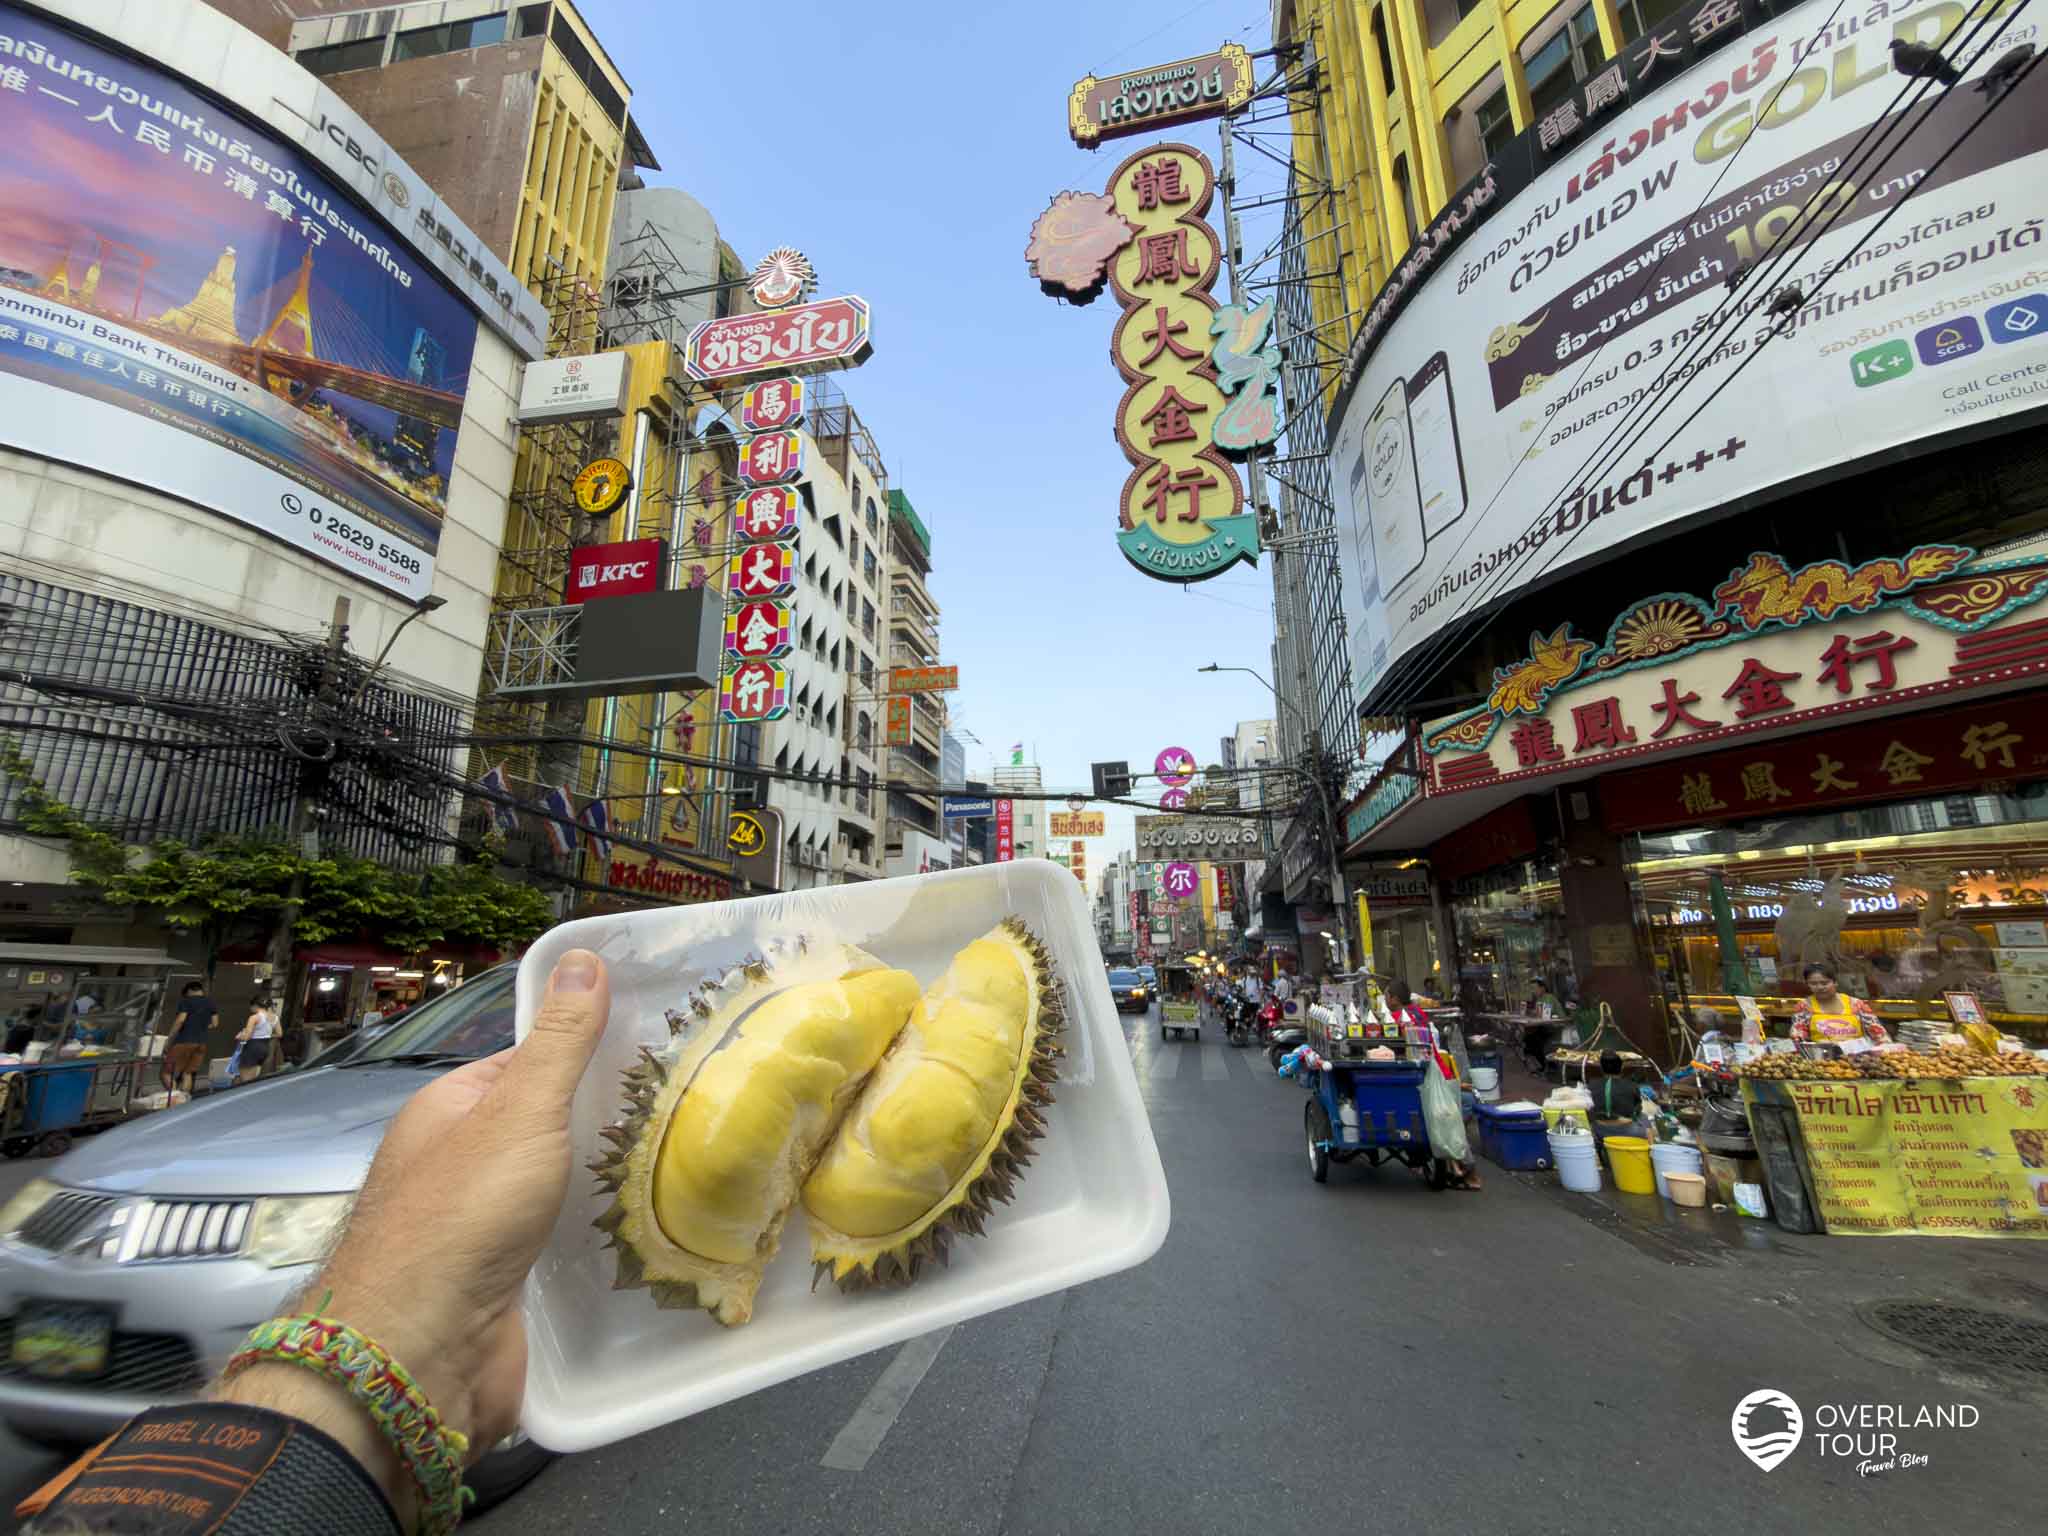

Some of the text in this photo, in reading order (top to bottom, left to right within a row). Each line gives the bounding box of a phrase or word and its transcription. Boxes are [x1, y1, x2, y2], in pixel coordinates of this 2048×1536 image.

[319, 114, 379, 178] ICBC
[1457, 36, 1778, 295] ซื้อทองกับ เล่งหงษ์
[1510, 161, 1678, 292] ด้วยแอพ
[1691, 156, 1842, 239] ไม่มีค่าใช้จ่าย
[1555, 299, 1650, 360] ซื้อ-ขาย
[1725, 179, 1856, 263] 100
[1870, 168, 1926, 201] บาท
[0, 295, 238, 392] nminbi Bank Thailand
[703, 311, 849, 370] ทองใบ
[1131, 157, 1218, 523] 龍鳳大金行
[1856, 353, 1905, 379] K+
[1936, 343, 1967, 358] SCB
[1545, 366, 1619, 417] ออมครบ
[1624, 339, 1664, 372] 0.3
[1943, 380, 1981, 399] Call
[310, 508, 322, 524] 0
[327, 517, 374, 550] 2629
[378, 543, 421, 575] 5588
[313, 531, 411, 585] www.icbcthai.com
[599, 561, 649, 582] KFC
[1509, 630, 1918, 766] 龍鳳大金行
[1679, 721, 2023, 815] 龍鳳大金行
[944, 801, 991, 812] Panasonic
[1748, 904, 1783, 918] ทอง
